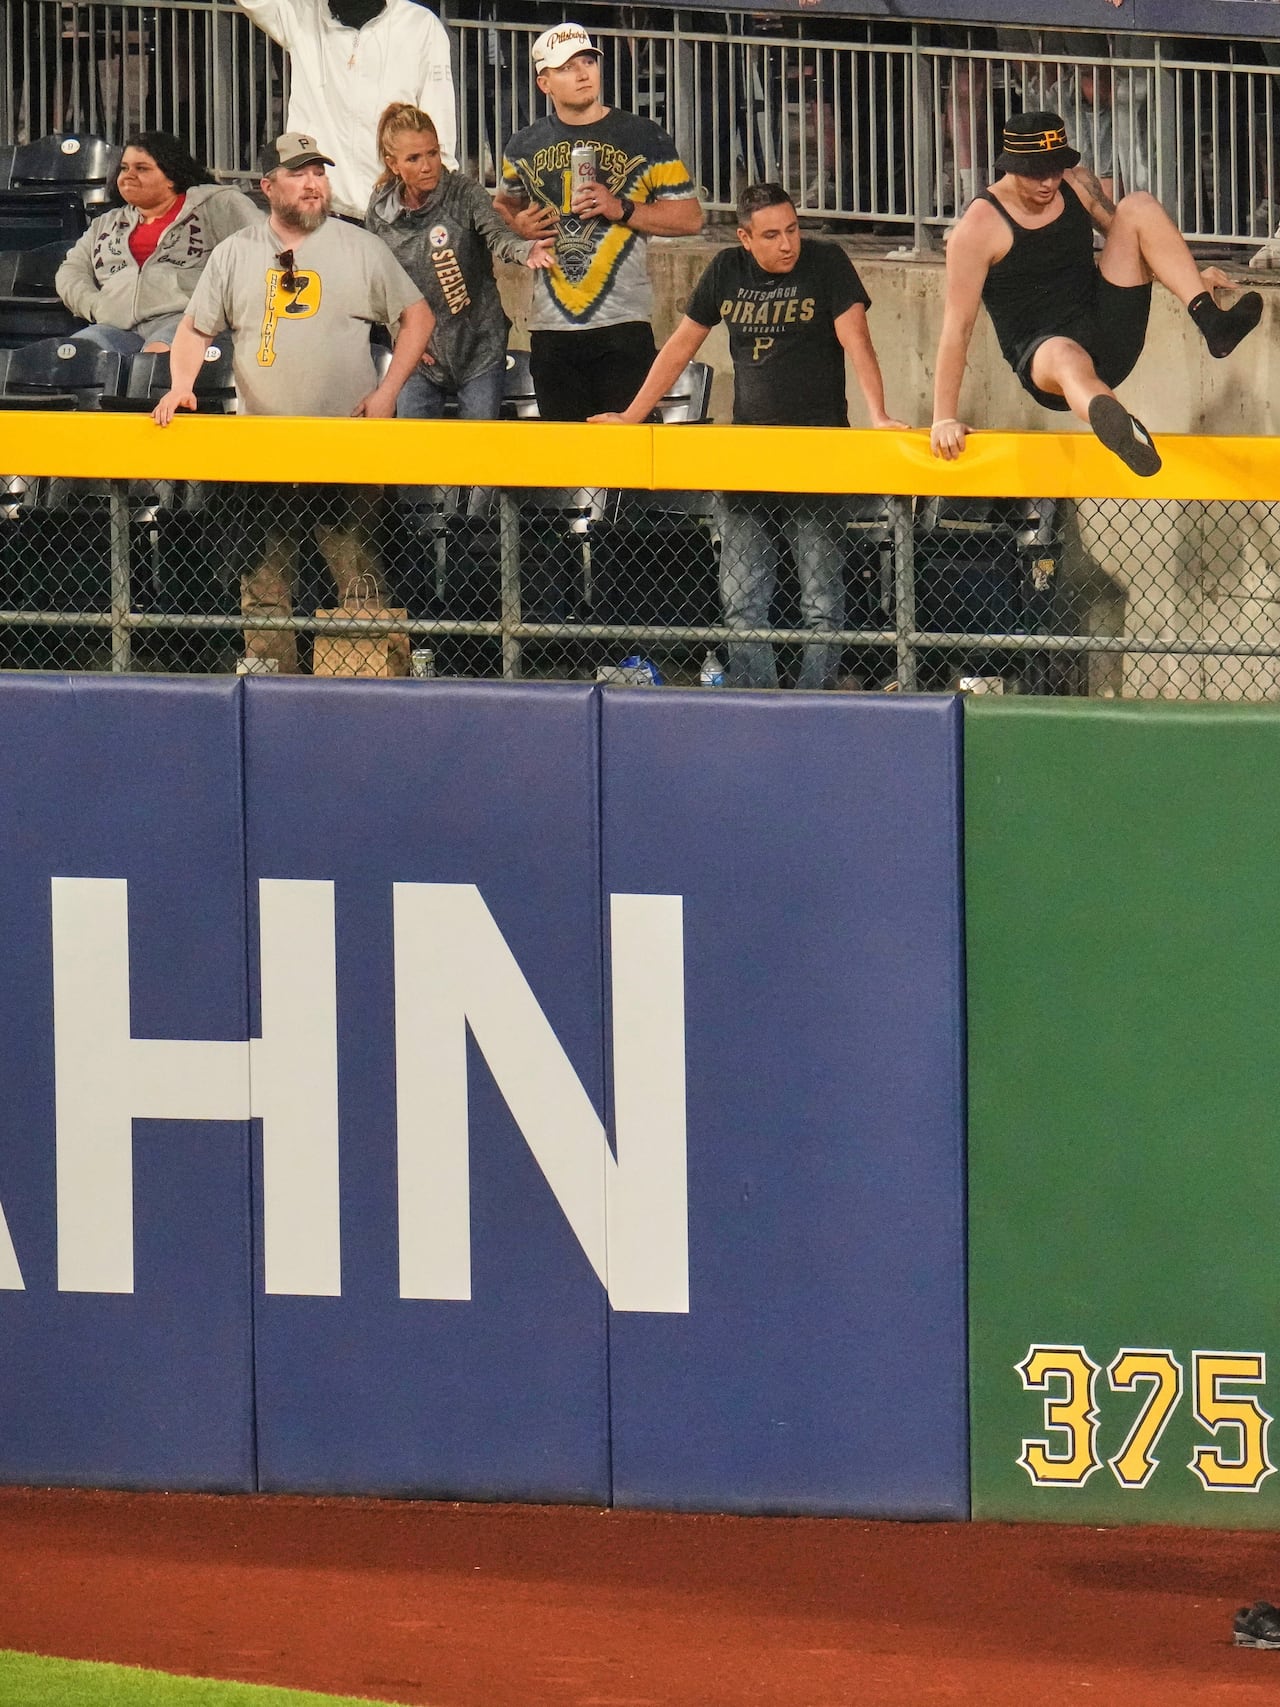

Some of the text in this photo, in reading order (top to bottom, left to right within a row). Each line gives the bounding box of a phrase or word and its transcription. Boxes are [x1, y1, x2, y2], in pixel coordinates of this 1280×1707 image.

[298, 138, 310, 150] P
[1044, 130, 1058, 150] P
[533, 140, 628, 181] PIRES
[432, 249, 472, 314] STEELERS
[737, 286, 798, 301] PITTSBURGH
[720, 297, 816, 325] PIRATES
[742, 325, 786, 333] BASEBALL
[752, 336, 775, 360] P
[1014, 1344, 1278, 1493] 375
